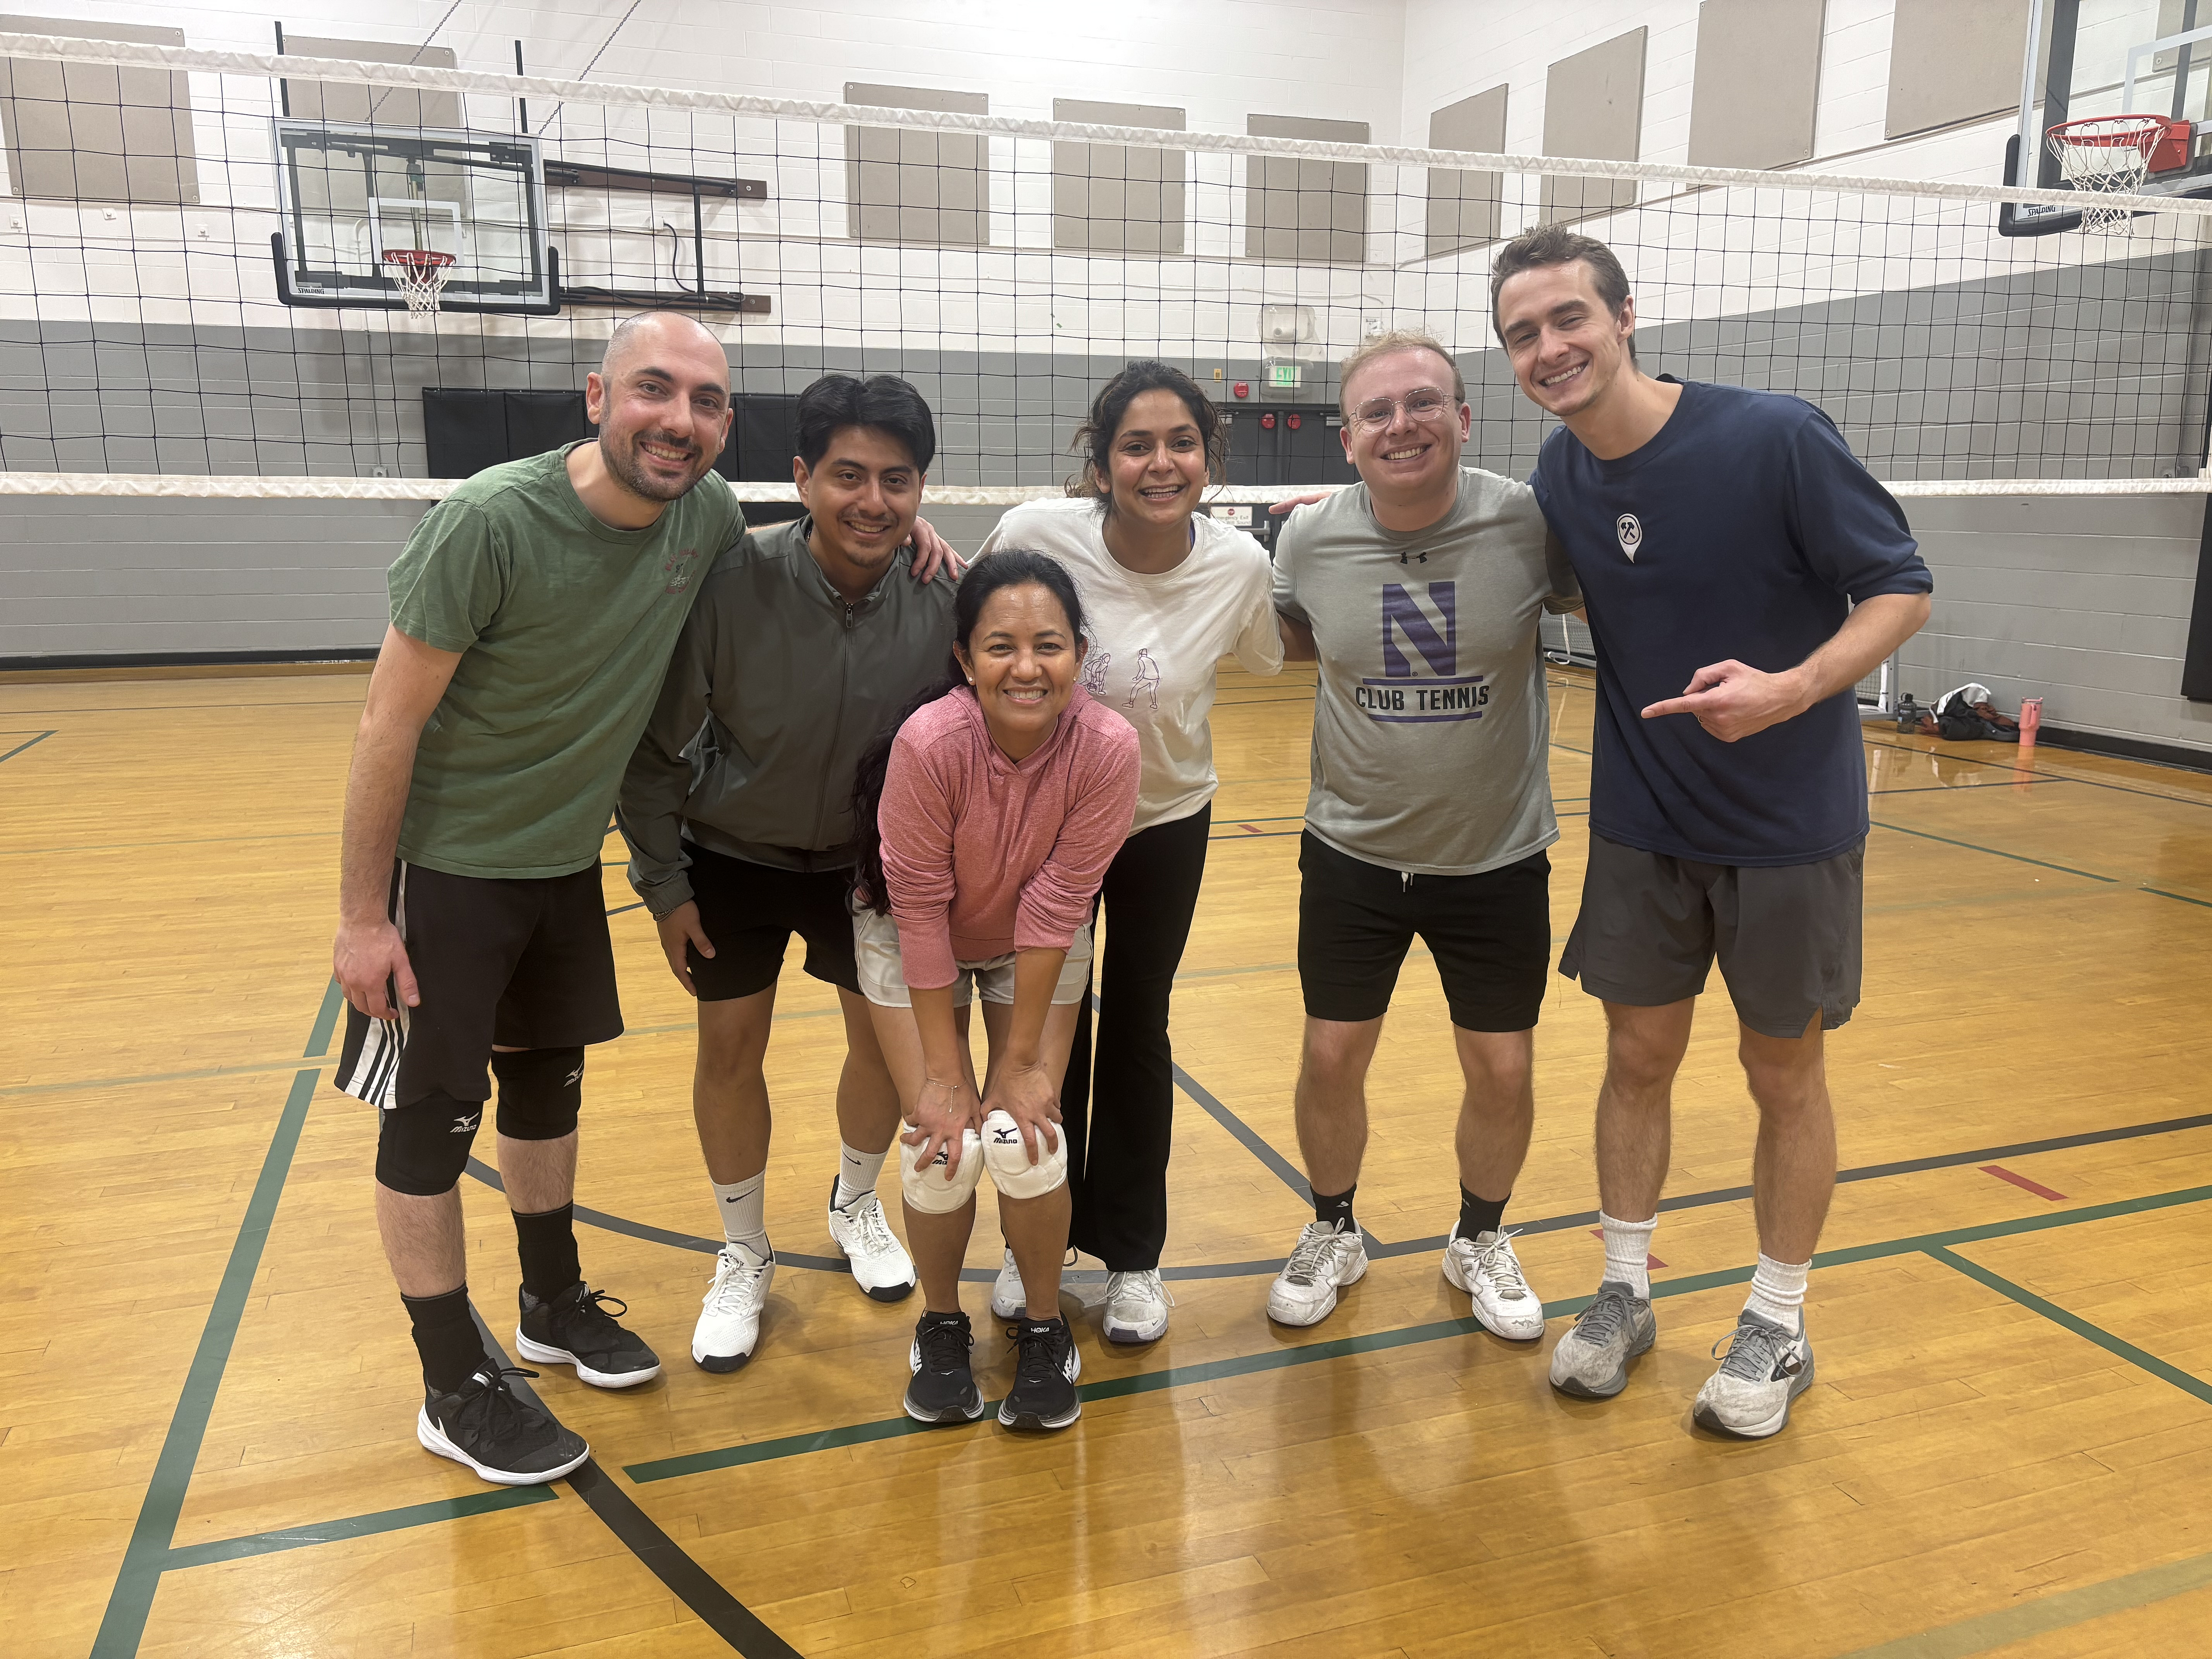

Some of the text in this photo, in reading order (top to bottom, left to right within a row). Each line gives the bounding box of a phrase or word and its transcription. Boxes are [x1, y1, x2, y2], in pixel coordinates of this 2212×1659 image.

[2028, 204, 2056, 216] SPALDING
[1276, 367, 1297, 385] EXIT
[1382, 581, 1456, 677] N
[1355, 685, 1490, 711] CLUB TENNIS
